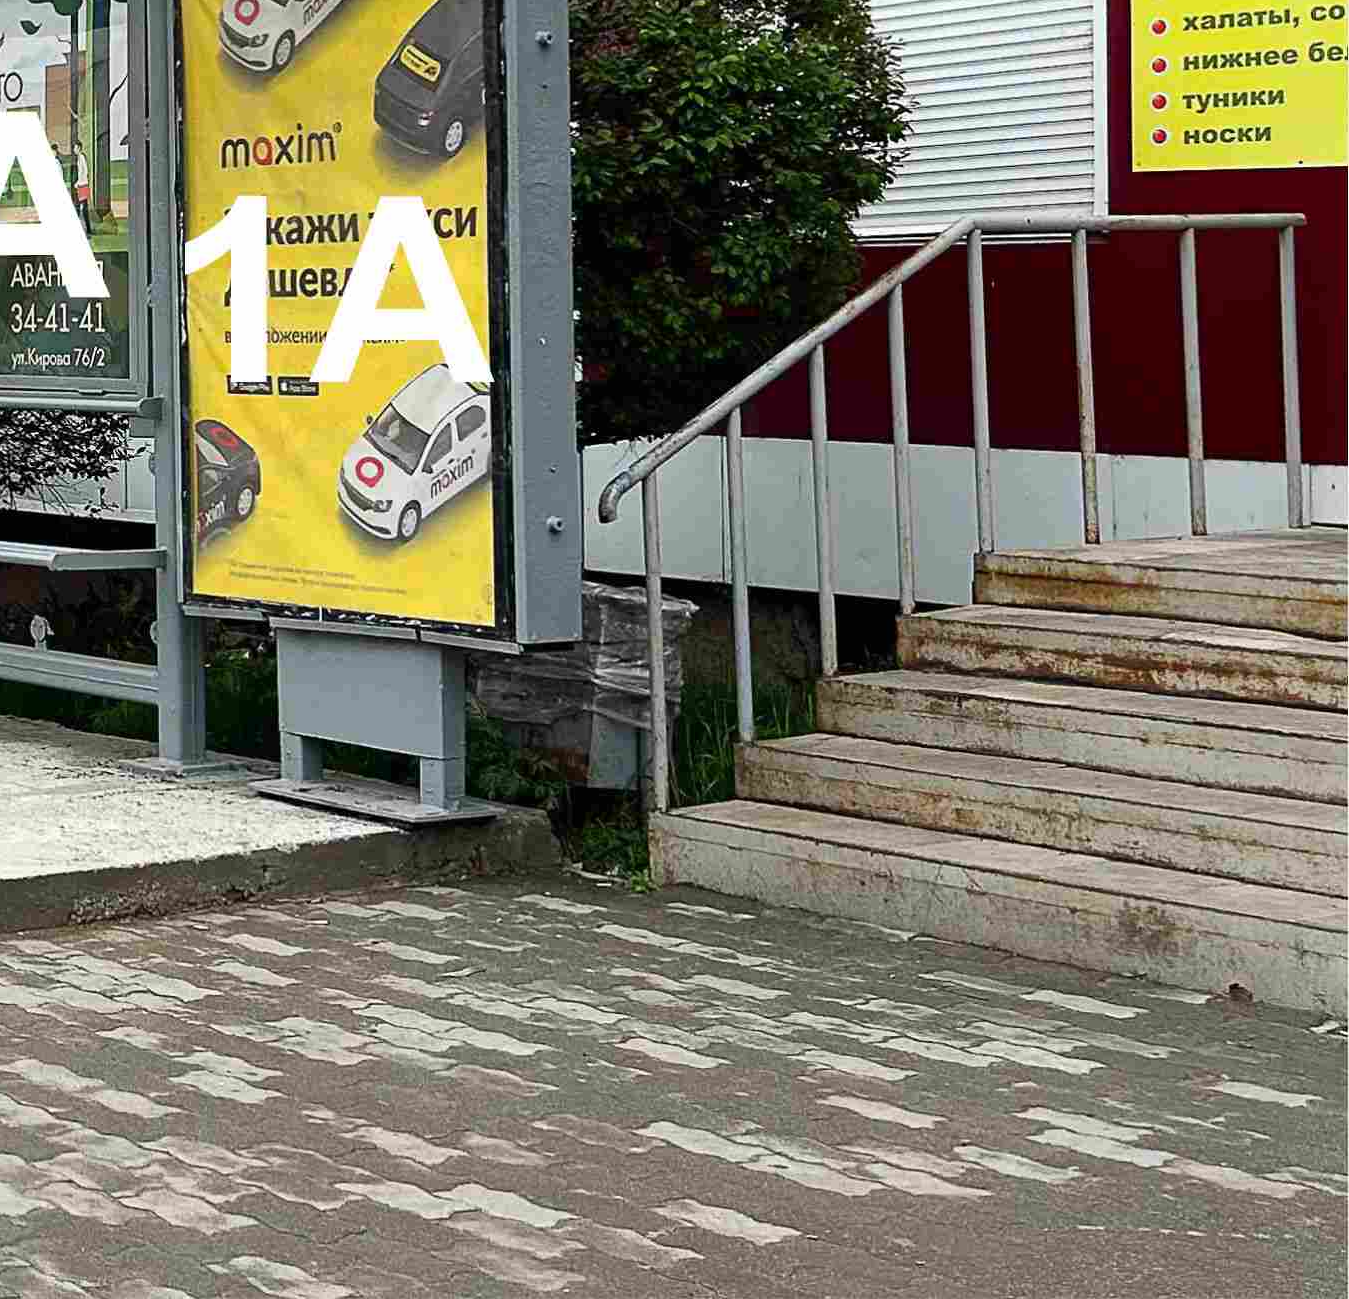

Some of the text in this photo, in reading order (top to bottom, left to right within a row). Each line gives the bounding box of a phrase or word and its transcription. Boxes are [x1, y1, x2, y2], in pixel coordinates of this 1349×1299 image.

[1183, 7, 1300, 31] халаты,
[1183, 46, 1298, 71] нижнее
[1182, 88, 1285, 114] туники
[1183, 125, 1272, 145] носки
[10, 302, 105, 334] 34-41-41
[73, 347, 105, 368] 76/2
